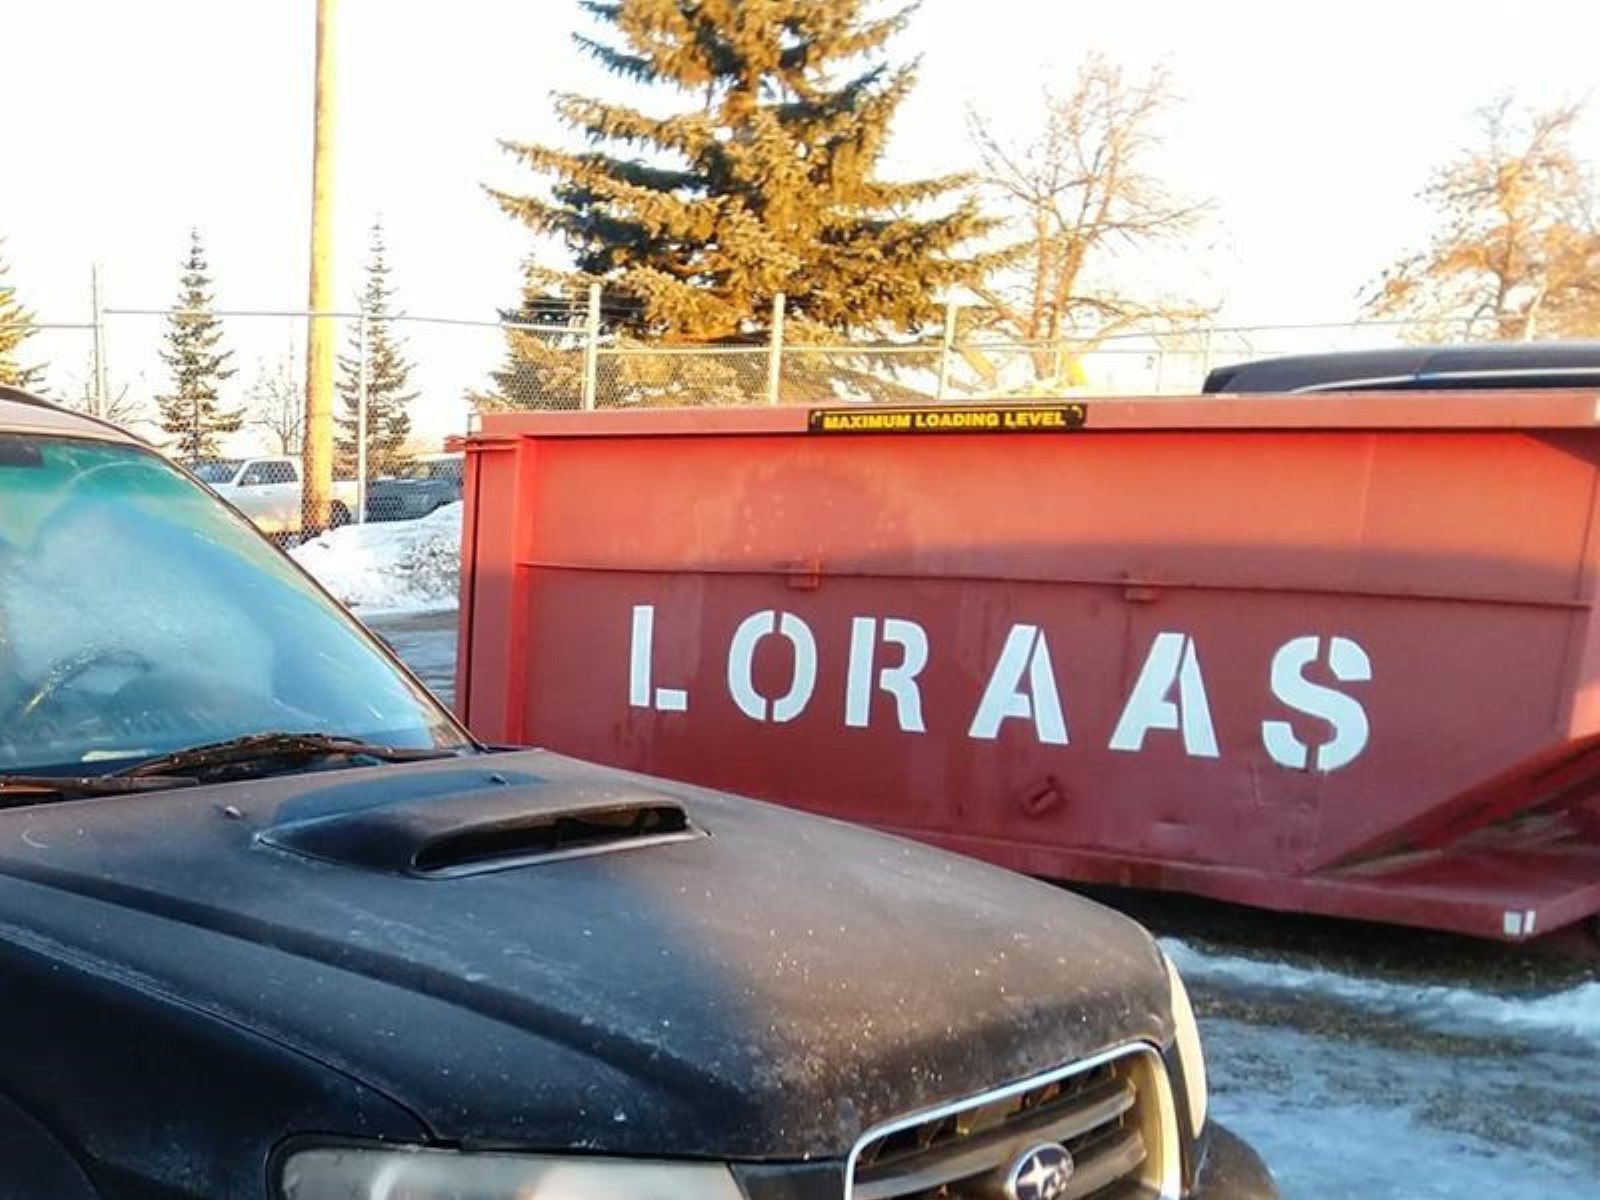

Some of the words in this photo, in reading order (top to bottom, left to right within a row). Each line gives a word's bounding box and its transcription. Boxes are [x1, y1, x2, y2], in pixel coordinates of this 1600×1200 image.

[823, 413, 911, 430] MAXIMUM
[915, 412, 1000, 428] LOADING
[1004, 410, 1066, 427] LEVEL
[629, 605, 1372, 771] LORAAS
